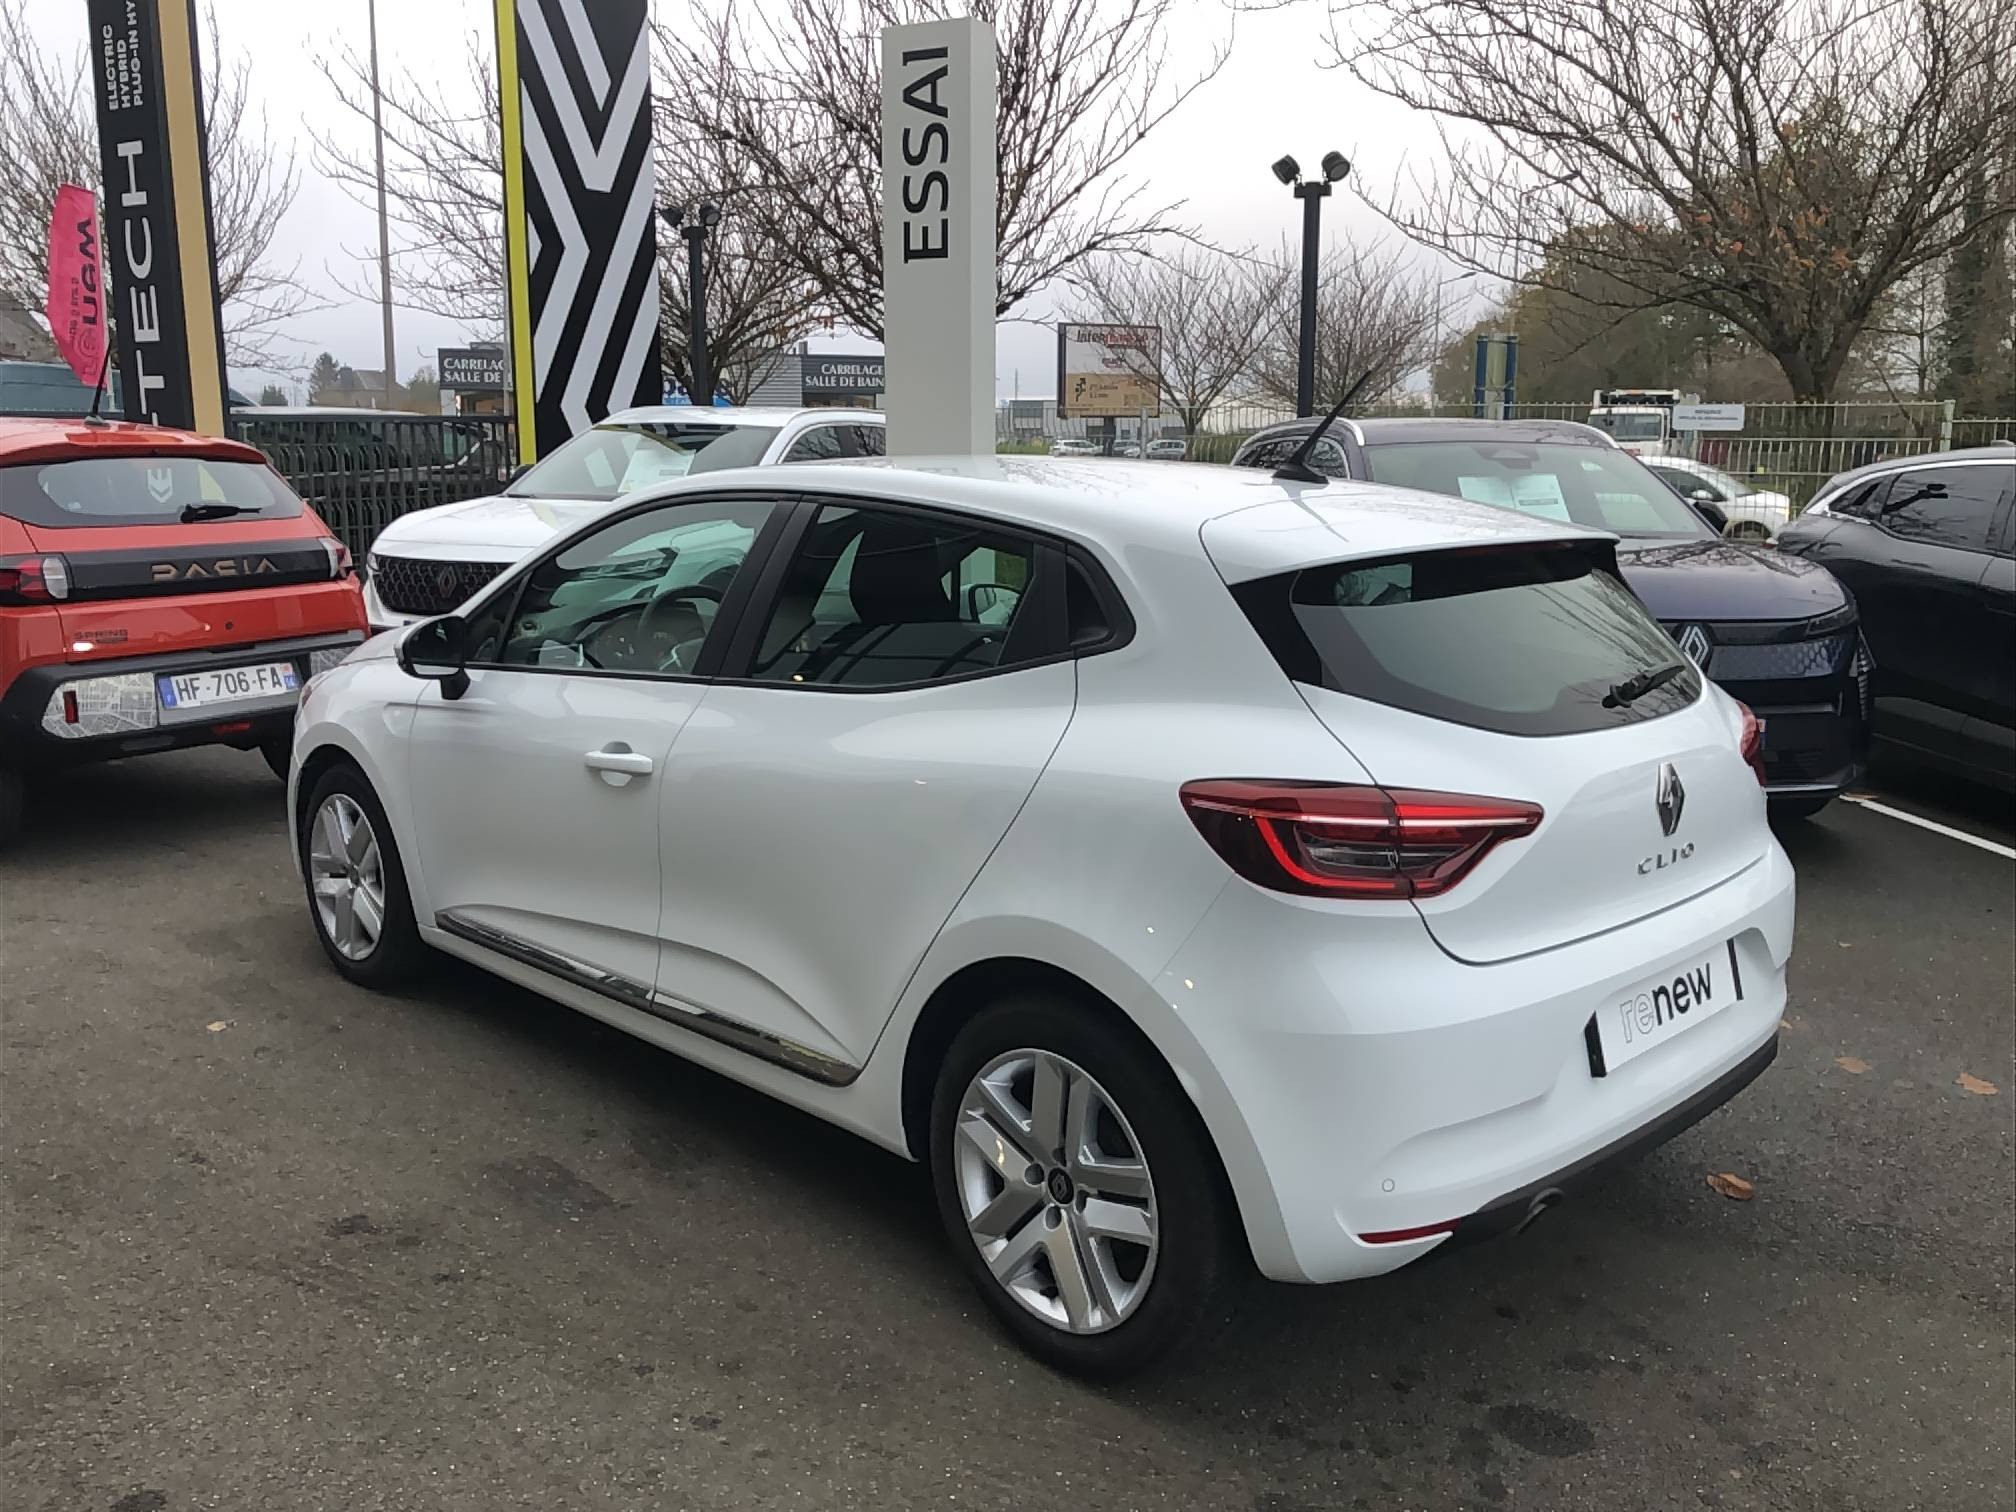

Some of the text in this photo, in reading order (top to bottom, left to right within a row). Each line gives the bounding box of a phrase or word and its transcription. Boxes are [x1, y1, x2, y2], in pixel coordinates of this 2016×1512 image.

[103, 24, 119, 111] ELECTRIC
[117, 39, 131, 108] HYBRID
[128, 29, 143, 106] PLUG-IN
[902, 46, 949, 264] ESSAI
[444, 371, 500, 383] SALLE DE
[805, 376, 837, 387] SALLE
[840, 377, 854, 387] DE
[821, 363, 884, 375] CARRELAGE
[151, 558, 280, 580] DACIA
[1638, 842, 1695, 875] CLIO
[1620, 962, 1712, 1044] renew
